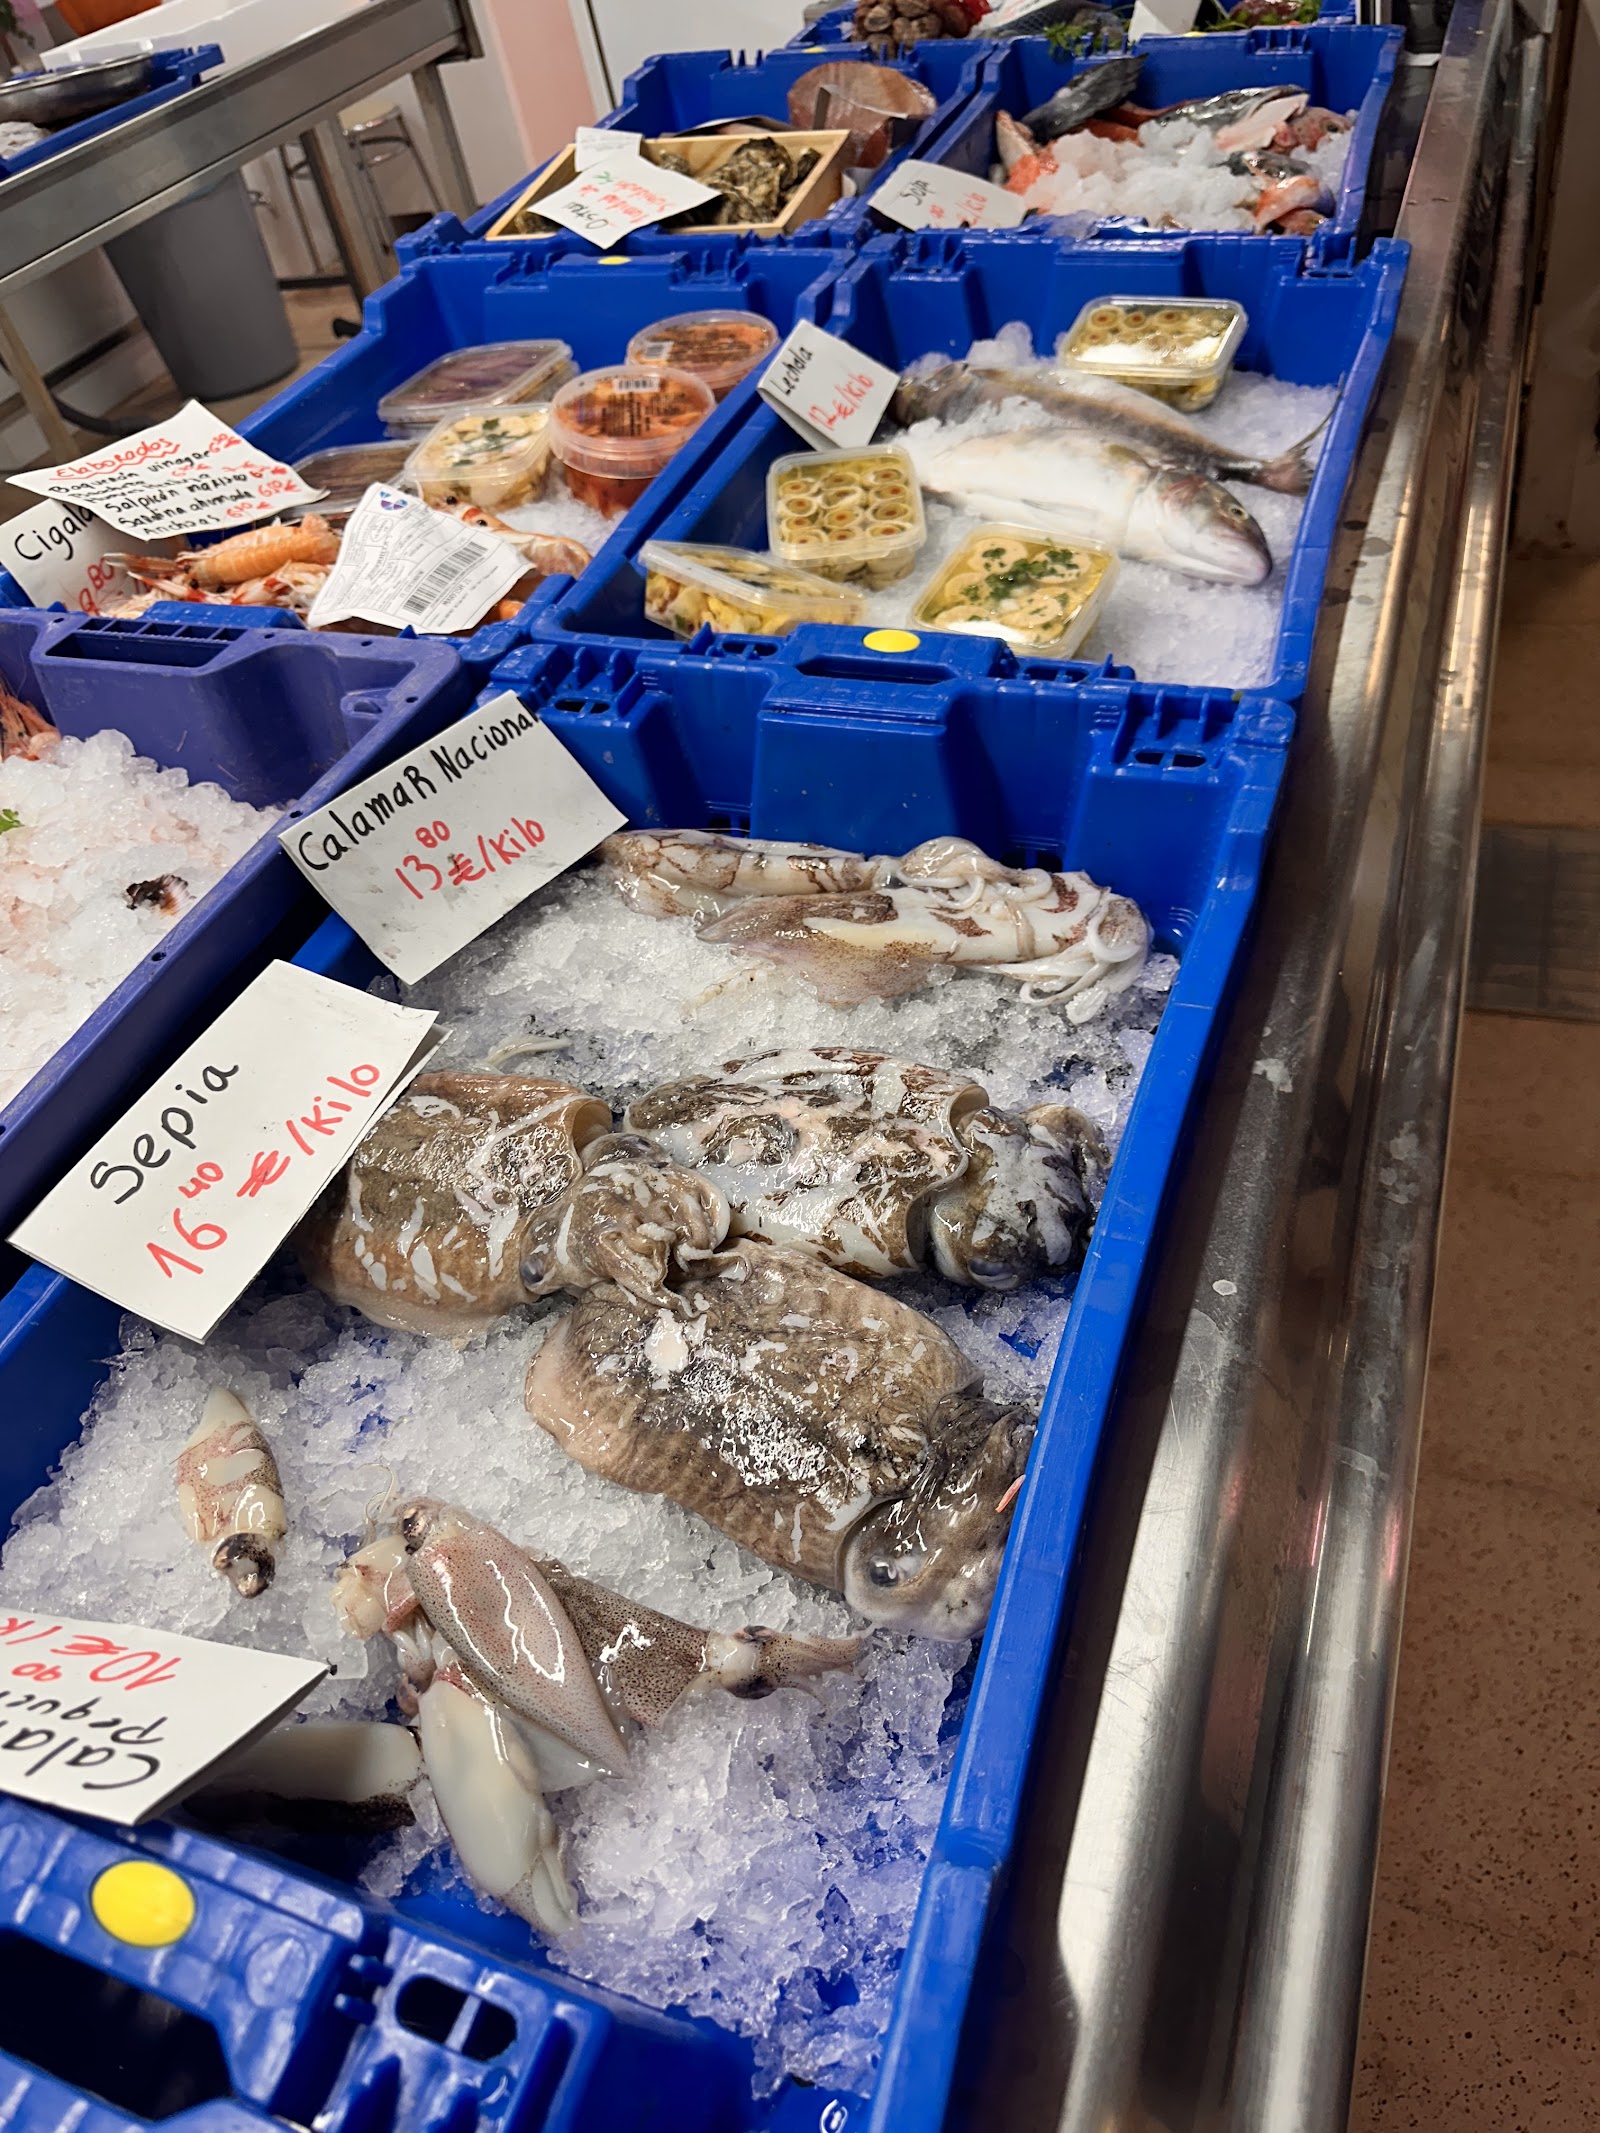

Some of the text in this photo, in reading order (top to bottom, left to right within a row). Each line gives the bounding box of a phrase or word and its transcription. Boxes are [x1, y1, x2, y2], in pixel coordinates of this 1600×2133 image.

[430, 696, 540, 783] Nacional
[90, 1064, 240, 1204] Sepia
[0, 1690, 168, 1744] Peque
[0, 1720, 160, 1790] Cala
